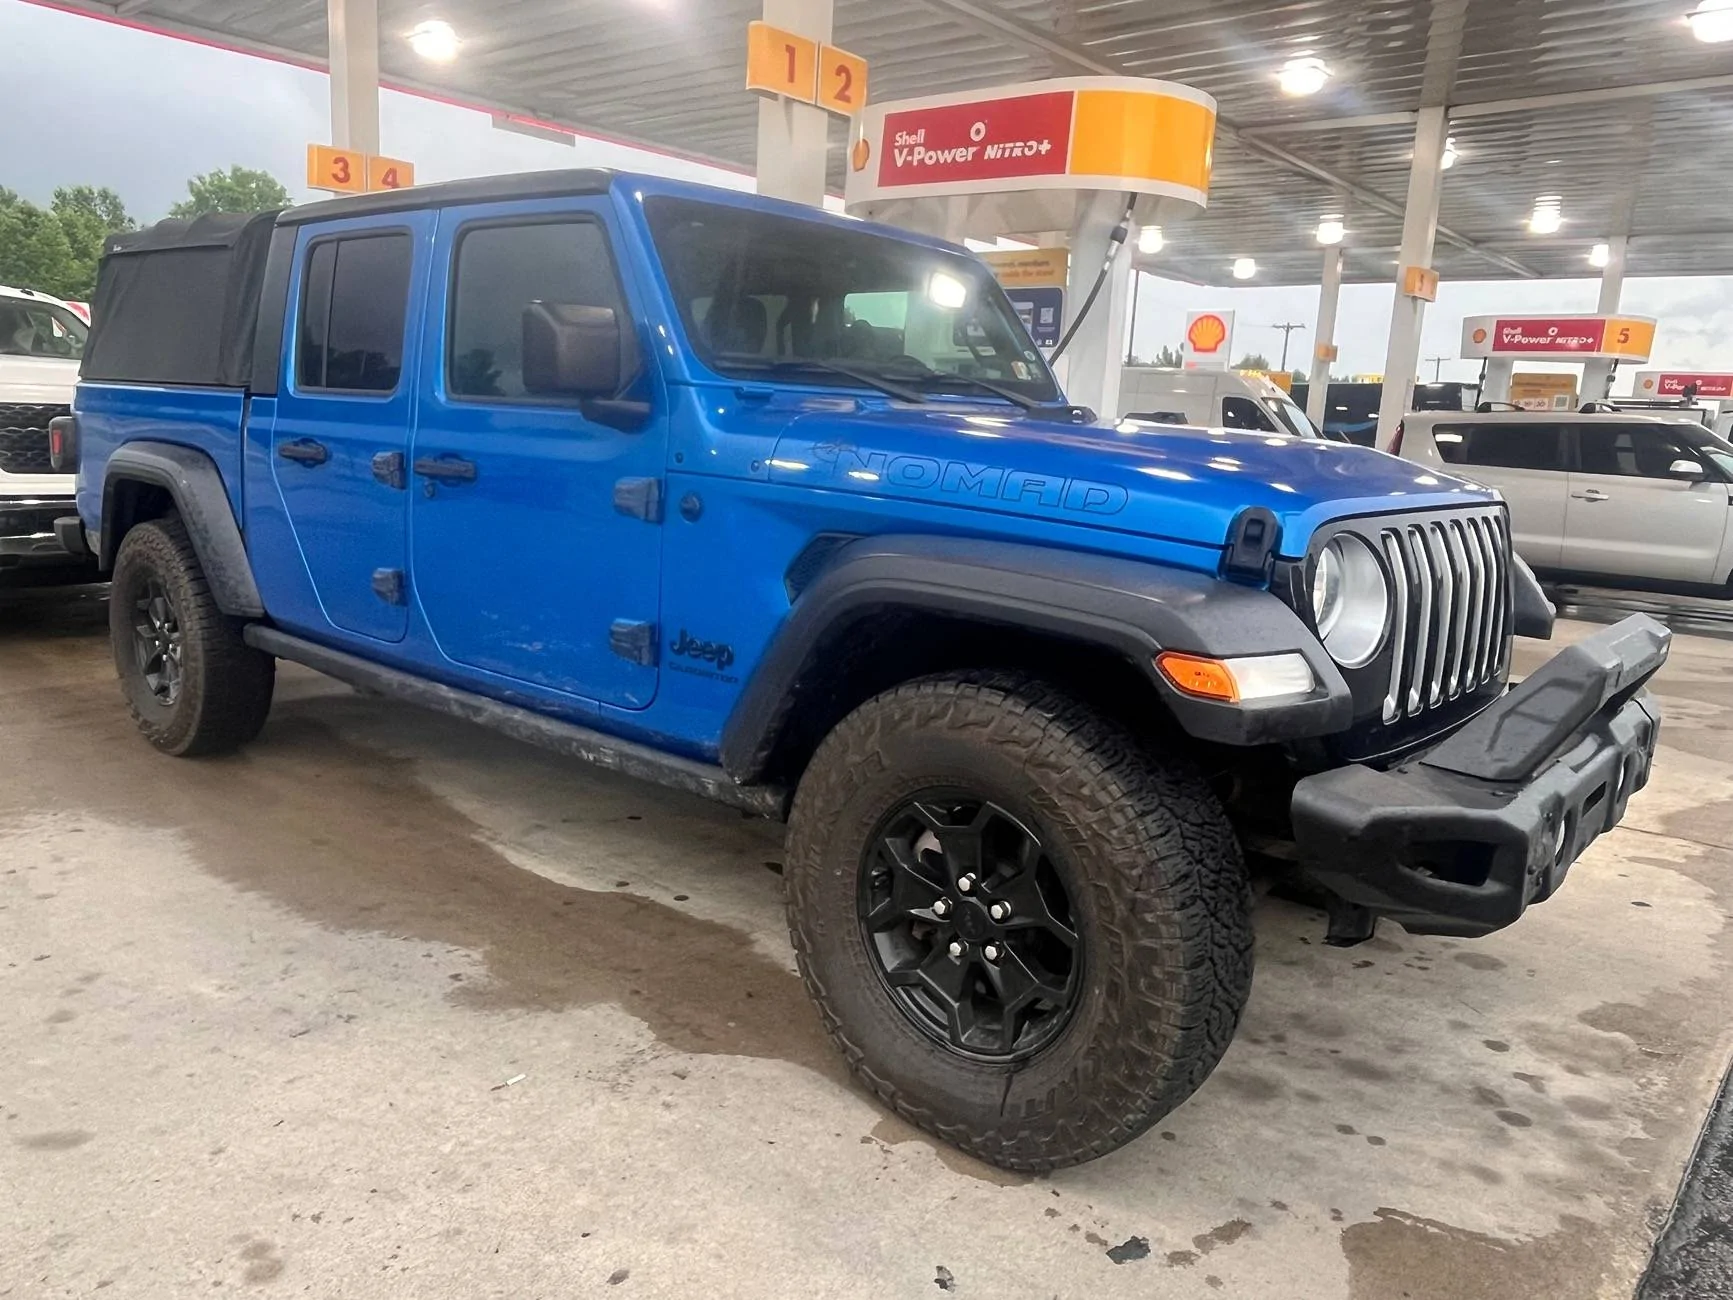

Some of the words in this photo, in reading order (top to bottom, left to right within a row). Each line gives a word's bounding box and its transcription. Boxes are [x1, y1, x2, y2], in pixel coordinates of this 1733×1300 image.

[785, 44, 796, 83] 1
[834, 64, 852, 104] 2
[894, 129, 925, 146] Shell
[894, 146, 980, 167] V-Power
[331, 156, 351, 183] 3
[381, 167, 400, 188] 4
[1503, 334, 1553, 344] V-Power
[1617, 327, 1630, 344] 5
[832, 448, 1129, 516] NOMAD
[670, 628, 734, 671] Jeep
